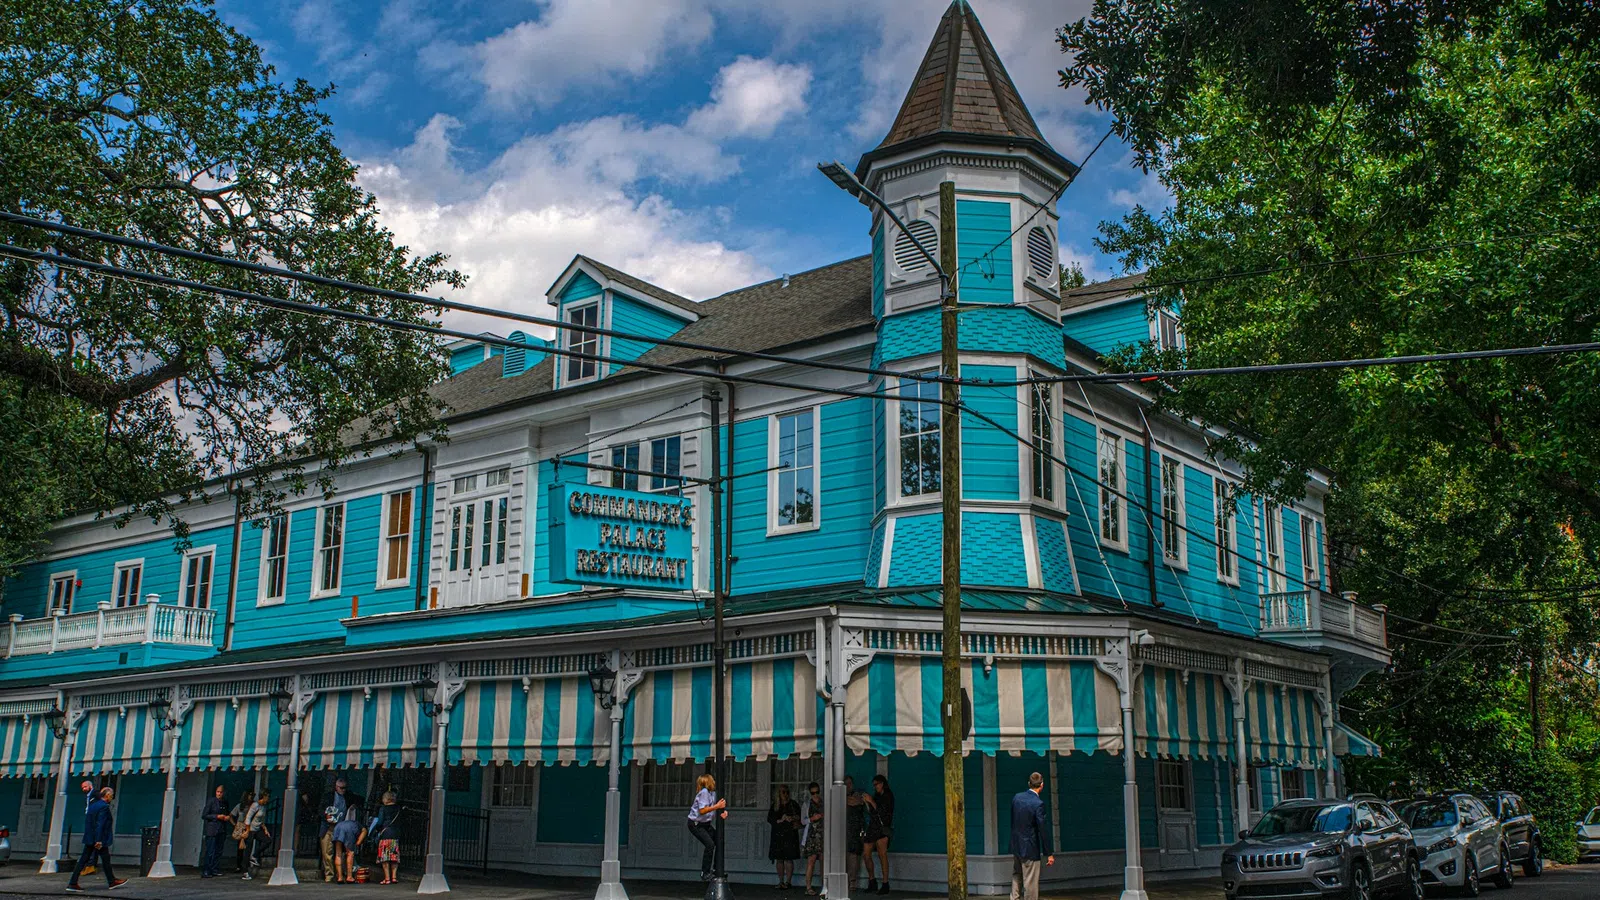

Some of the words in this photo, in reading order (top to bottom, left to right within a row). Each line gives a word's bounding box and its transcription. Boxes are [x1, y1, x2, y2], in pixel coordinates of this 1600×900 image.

[570, 491, 692, 526] COMMANDER'S
[600, 522, 666, 550] PALACE
[577, 549, 687, 578] RESTAURANT
